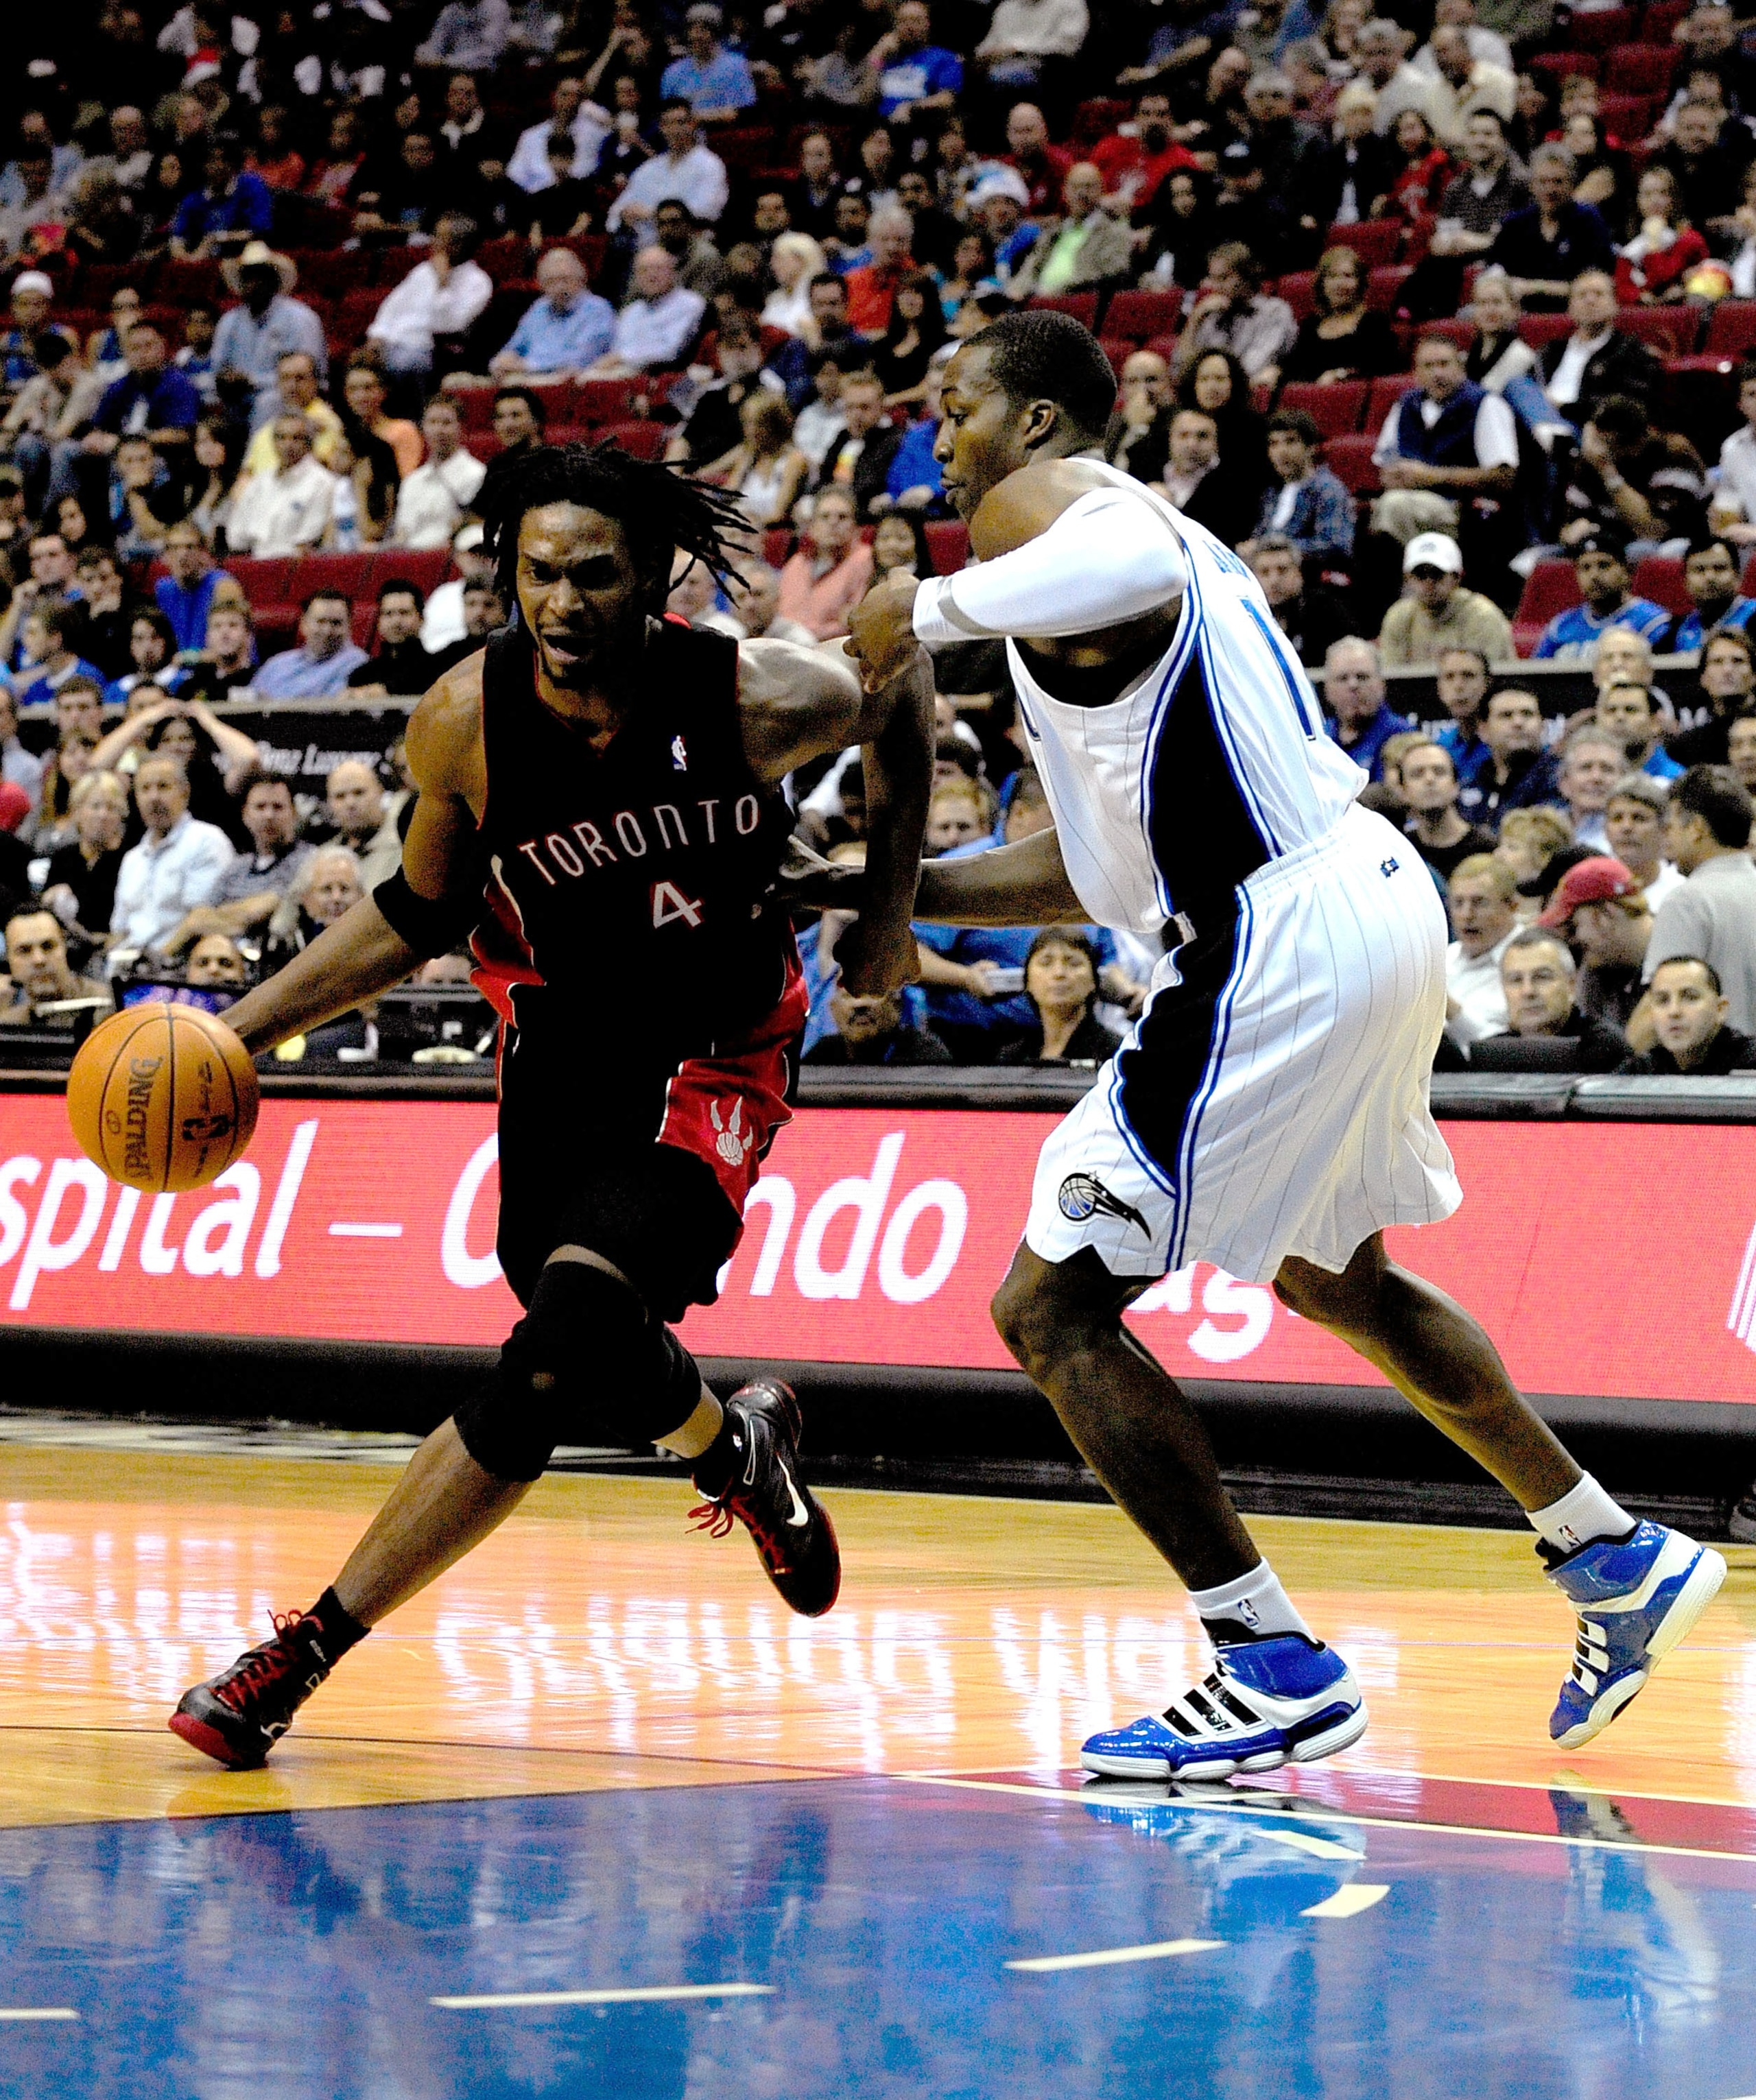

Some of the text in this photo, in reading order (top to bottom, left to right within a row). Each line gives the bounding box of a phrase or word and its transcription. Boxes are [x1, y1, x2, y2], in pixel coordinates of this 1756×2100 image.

[518, 794, 759, 885] TORONTO
[650, 880, 704, 929] 4
[124, 1055, 164, 1181] SPALDING
